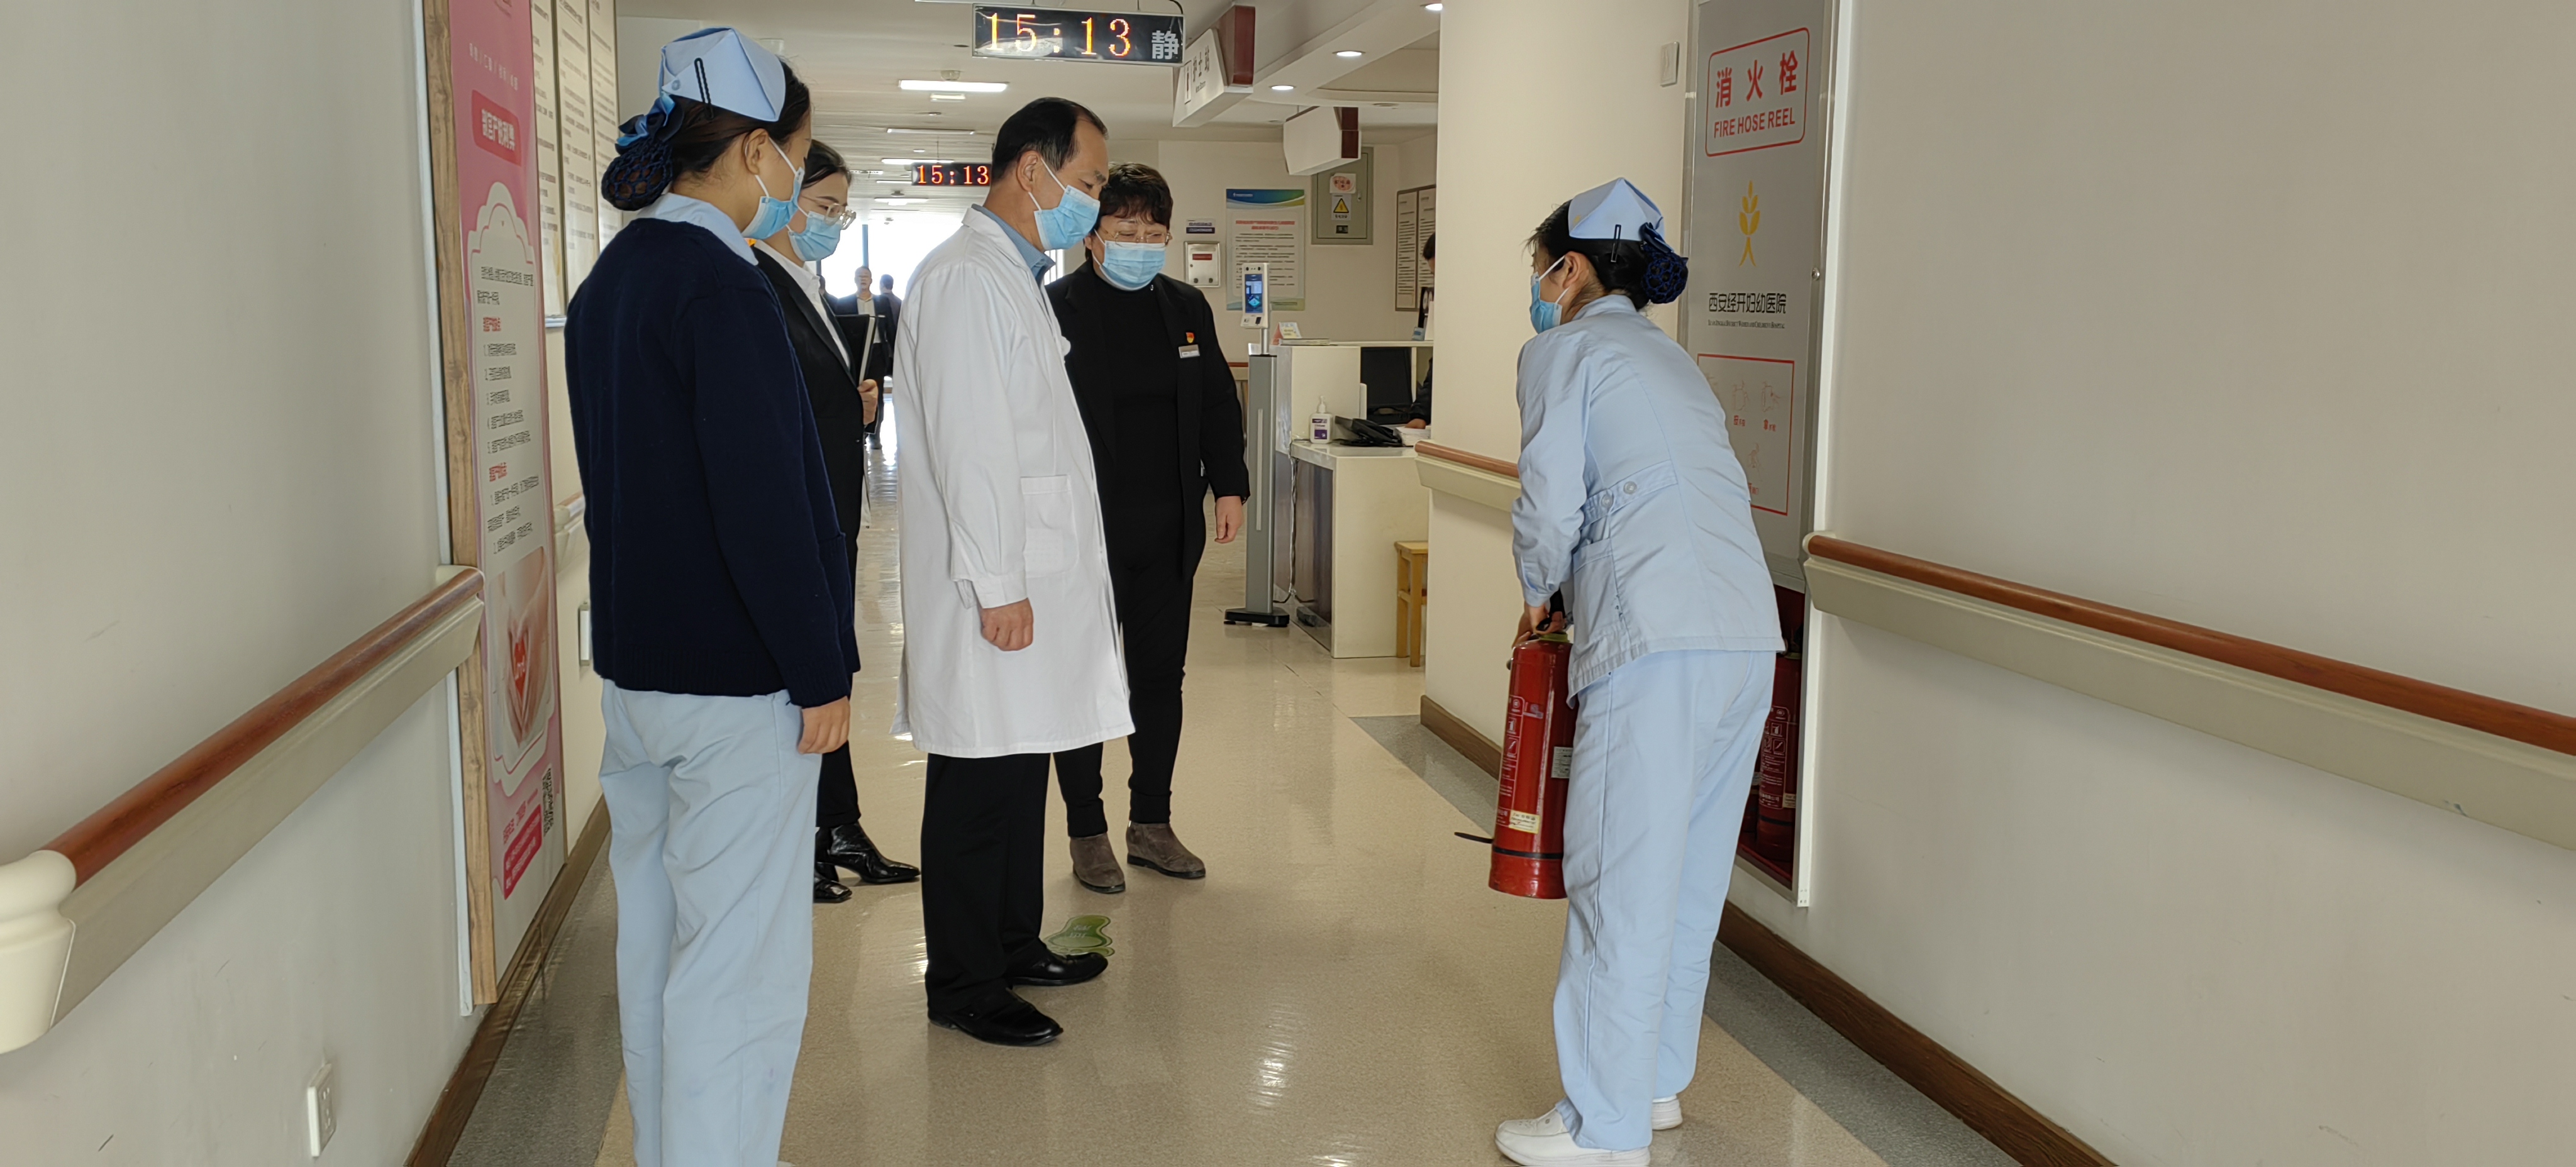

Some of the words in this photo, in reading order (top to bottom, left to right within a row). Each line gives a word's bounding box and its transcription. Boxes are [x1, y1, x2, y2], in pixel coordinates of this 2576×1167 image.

[986, 12, 1131, 57] 15:13
[1152, 30, 1179, 60] 静
[1715, 50, 1798, 109] 消火栓
[1714, 118, 1736, 139] FIRE
[1738, 112, 1765, 135] HOSE
[1767, 107, 1796, 130] REEL
[917, 164, 990, 185] 15:13
[1709, 292, 1787, 314] 西安经开妇幼医院
